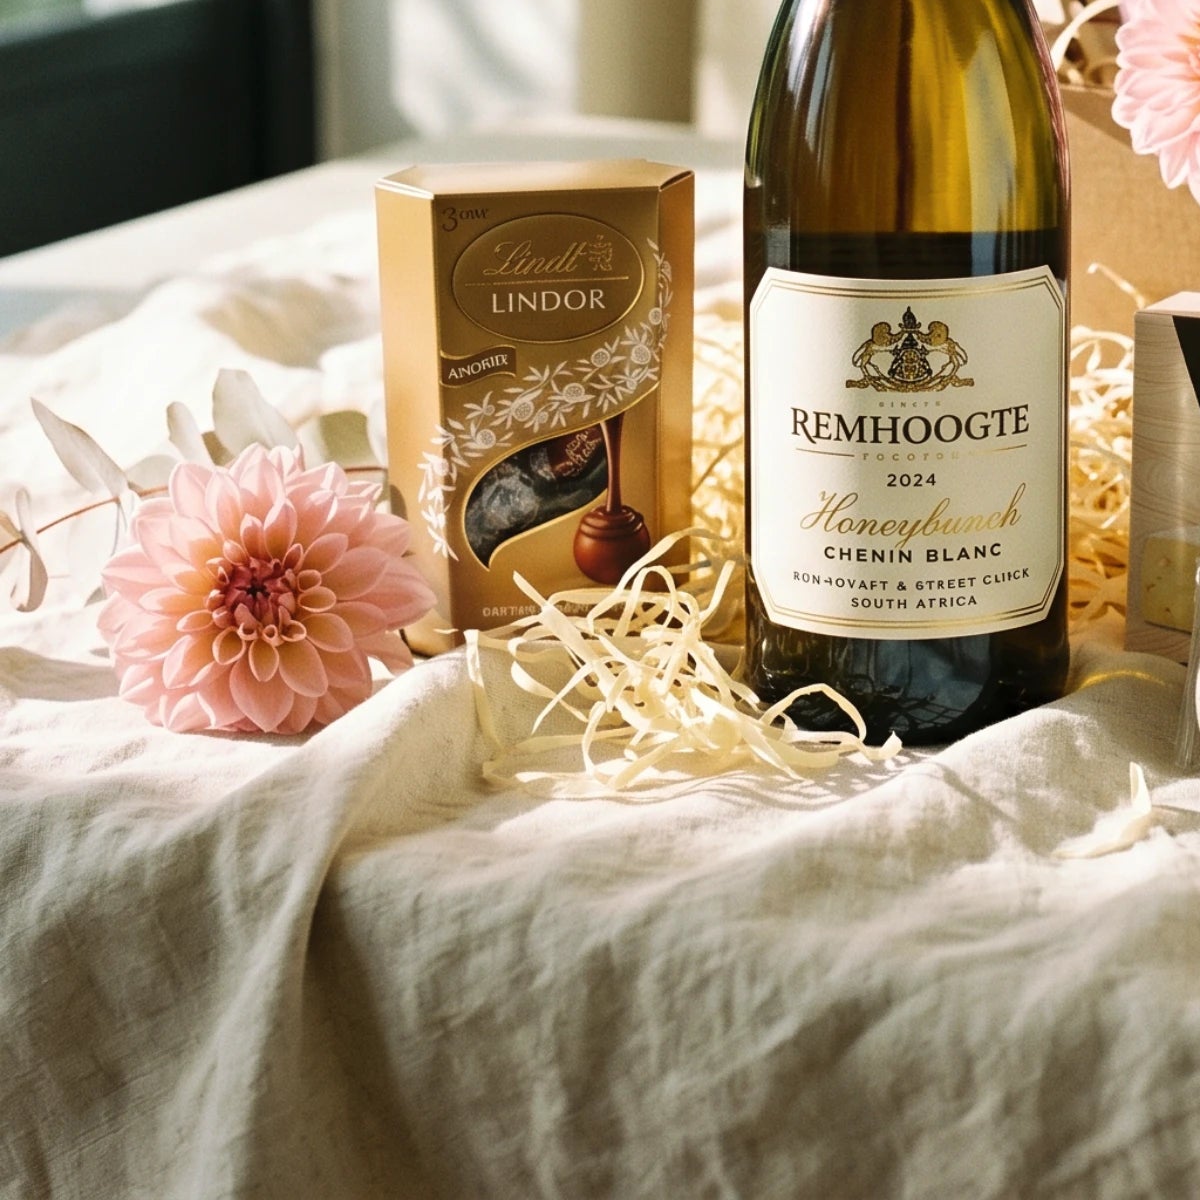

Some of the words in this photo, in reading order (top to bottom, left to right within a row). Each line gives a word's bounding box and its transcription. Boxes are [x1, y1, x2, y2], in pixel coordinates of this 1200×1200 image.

[483, 240, 587, 276] Lindt
[492, 289, 606, 313] LINDOR
[791, 404, 1029, 444] REMHOOGTE
[887, 473, 936, 487] 2024
[800, 482, 1026, 549] Honeybunch
[824, 546, 912, 563] CHENIN
[926, 543, 1002, 562] BLANC
[897, 581, 907, 591] &
[851, 597, 907, 609] SOUTH
